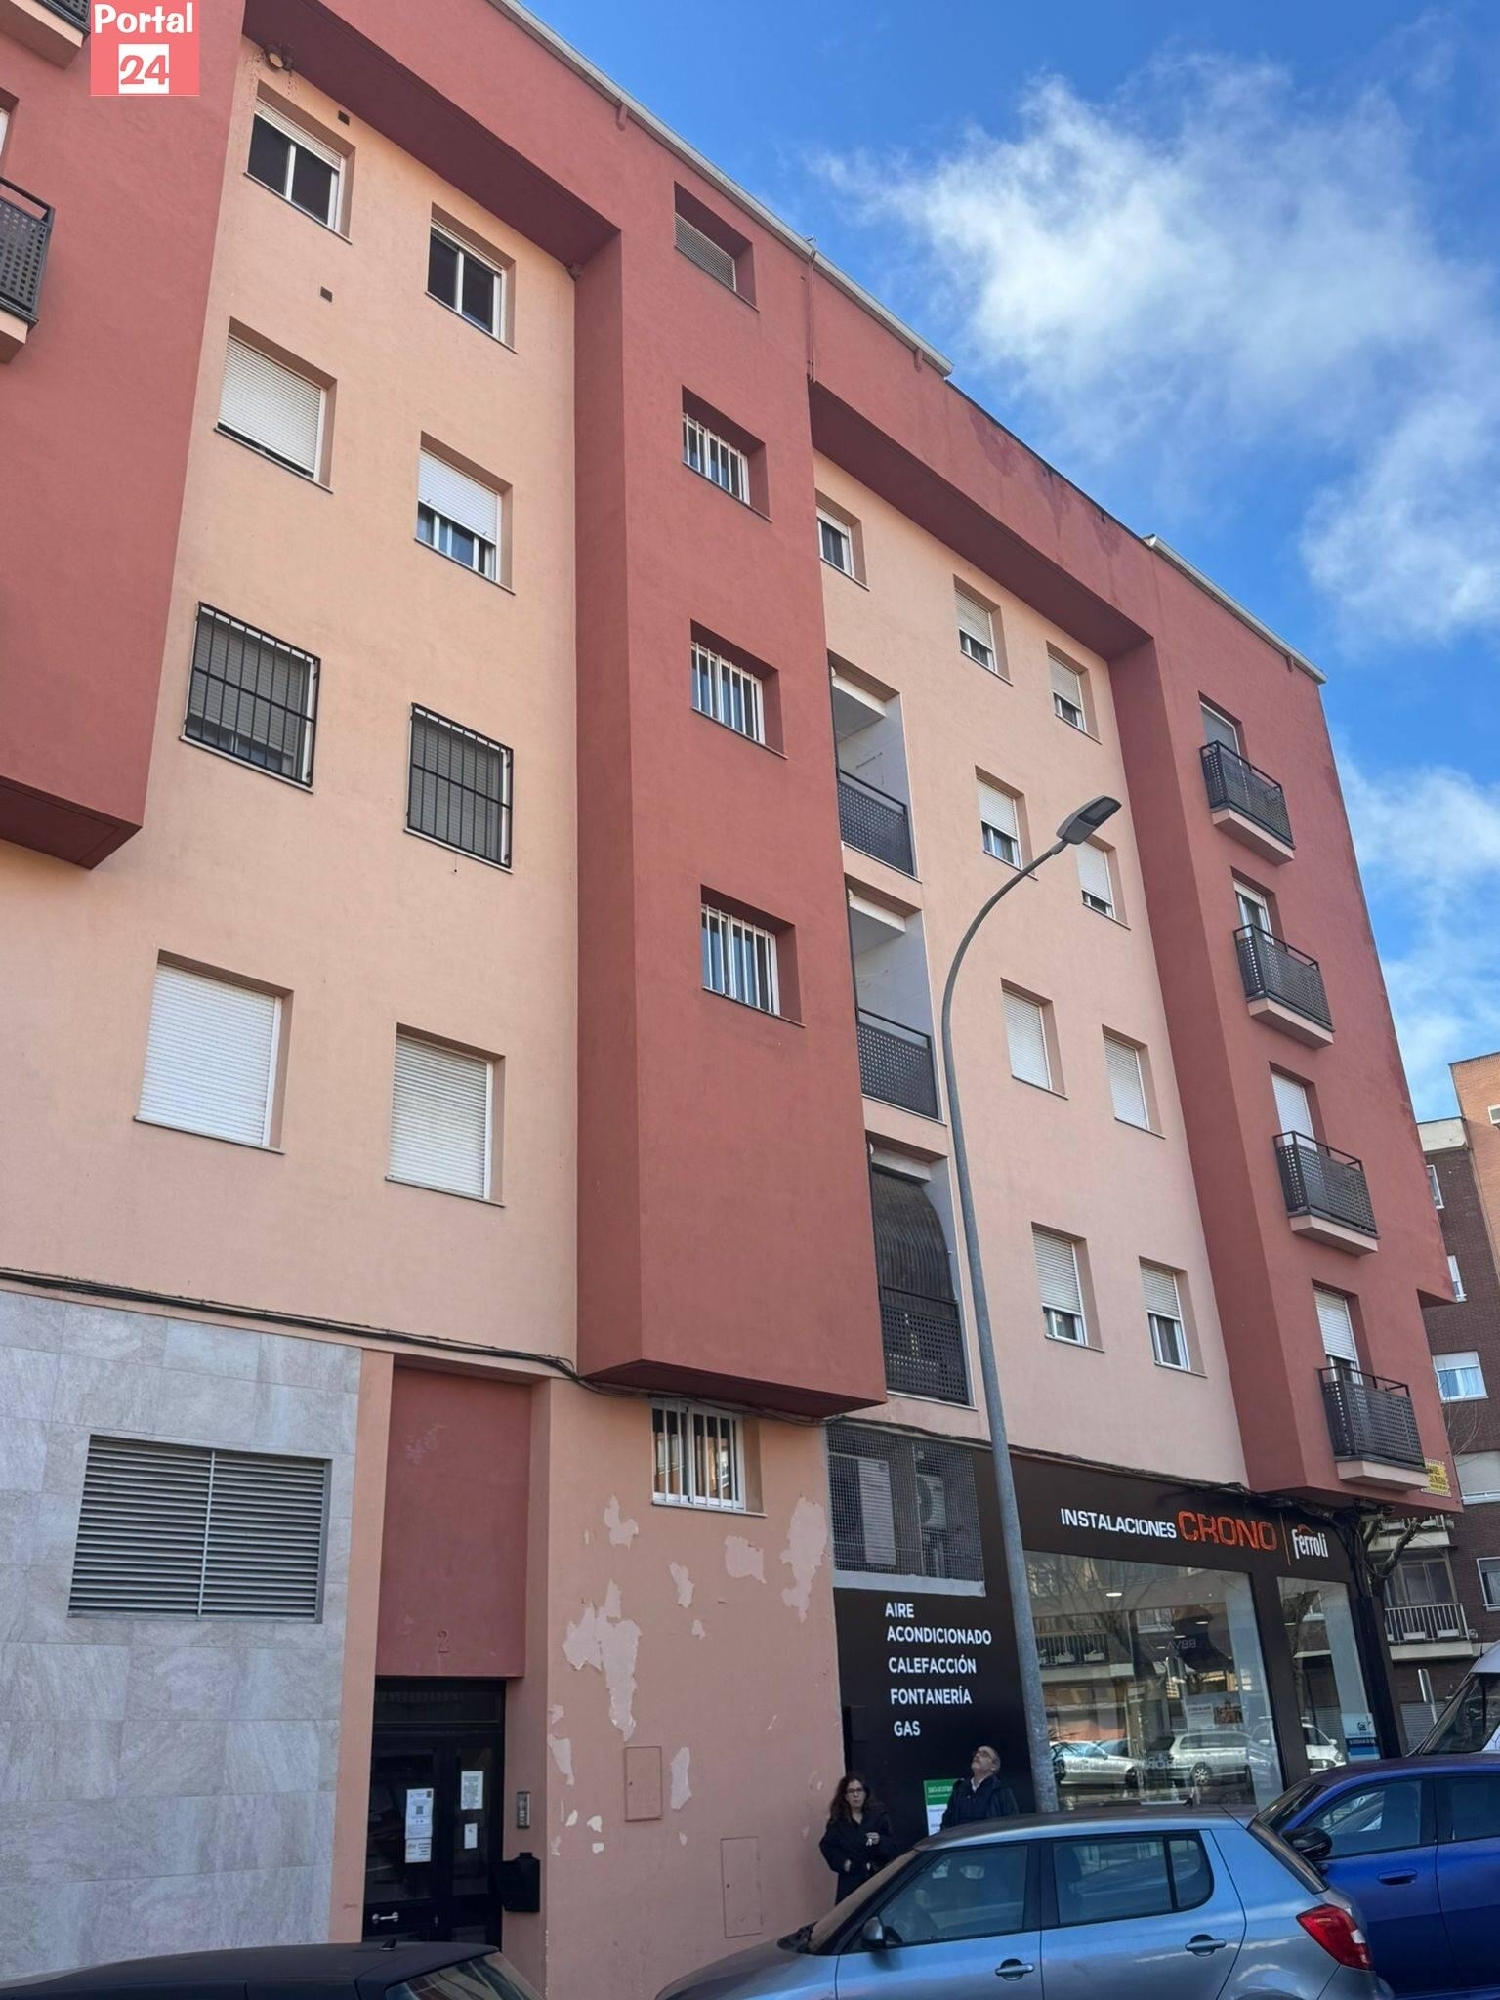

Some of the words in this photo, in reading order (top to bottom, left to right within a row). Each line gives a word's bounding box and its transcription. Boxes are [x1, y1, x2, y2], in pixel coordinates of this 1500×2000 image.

[1061, 1508, 1177, 1538] INSTALACIONES
[1178, 1510, 1277, 1551] CRONO
[885, 1602, 915, 1618] AIRE
[887, 1625, 992, 1645] ACONDICIONADO
[888, 1654, 977, 1674] CALEFACCIÓN
[890, 1685, 973, 1705] FONTANERÍA
[894, 1720, 921, 1736] GAS
